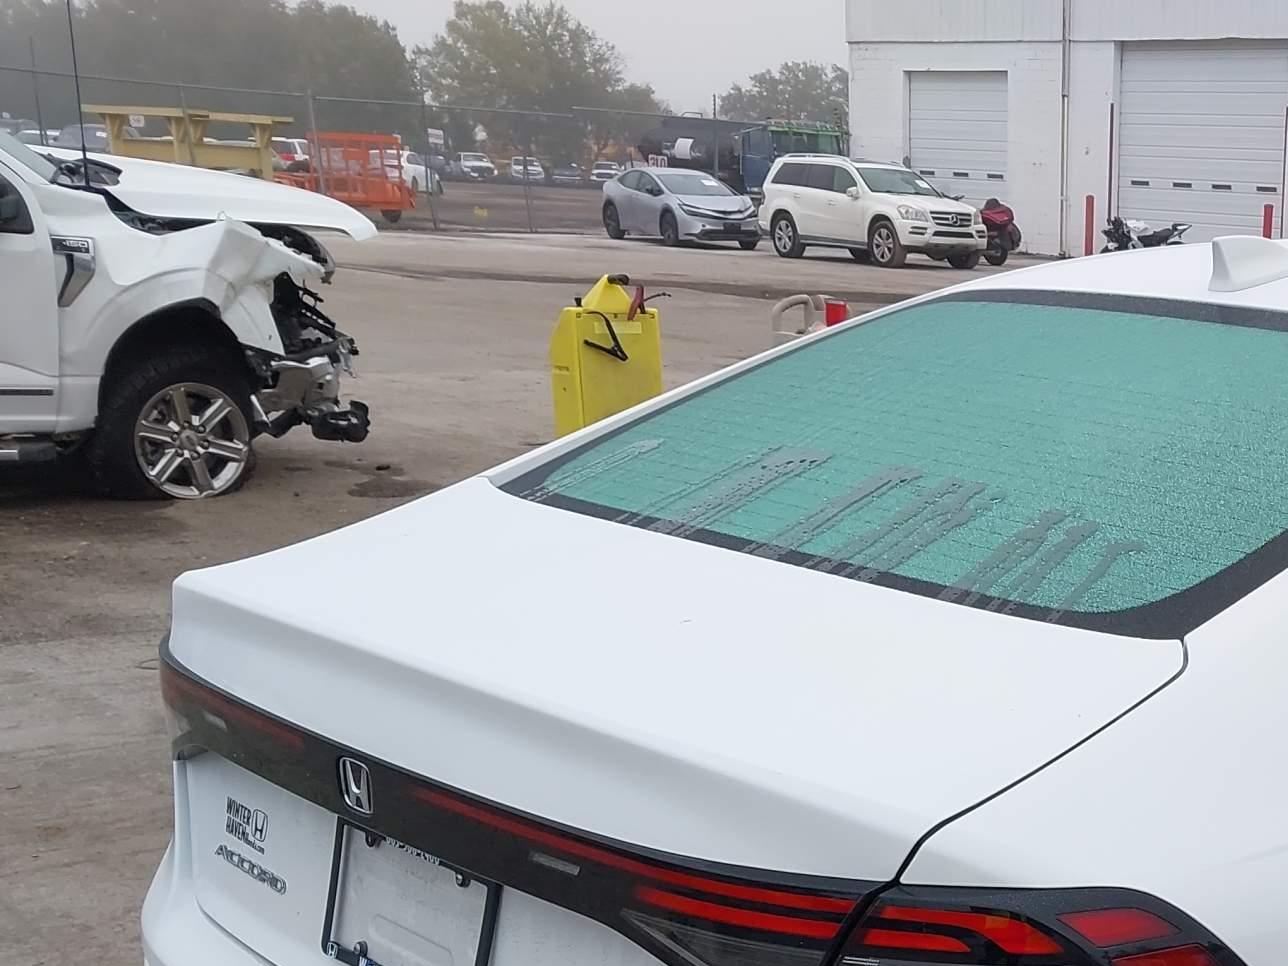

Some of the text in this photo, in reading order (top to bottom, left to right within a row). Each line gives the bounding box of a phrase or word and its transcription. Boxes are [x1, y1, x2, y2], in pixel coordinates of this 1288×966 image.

[226, 796, 251, 827] WINTER
[225, 815, 247, 841] HAVEN
[214, 844, 287, 895] ACCORD
